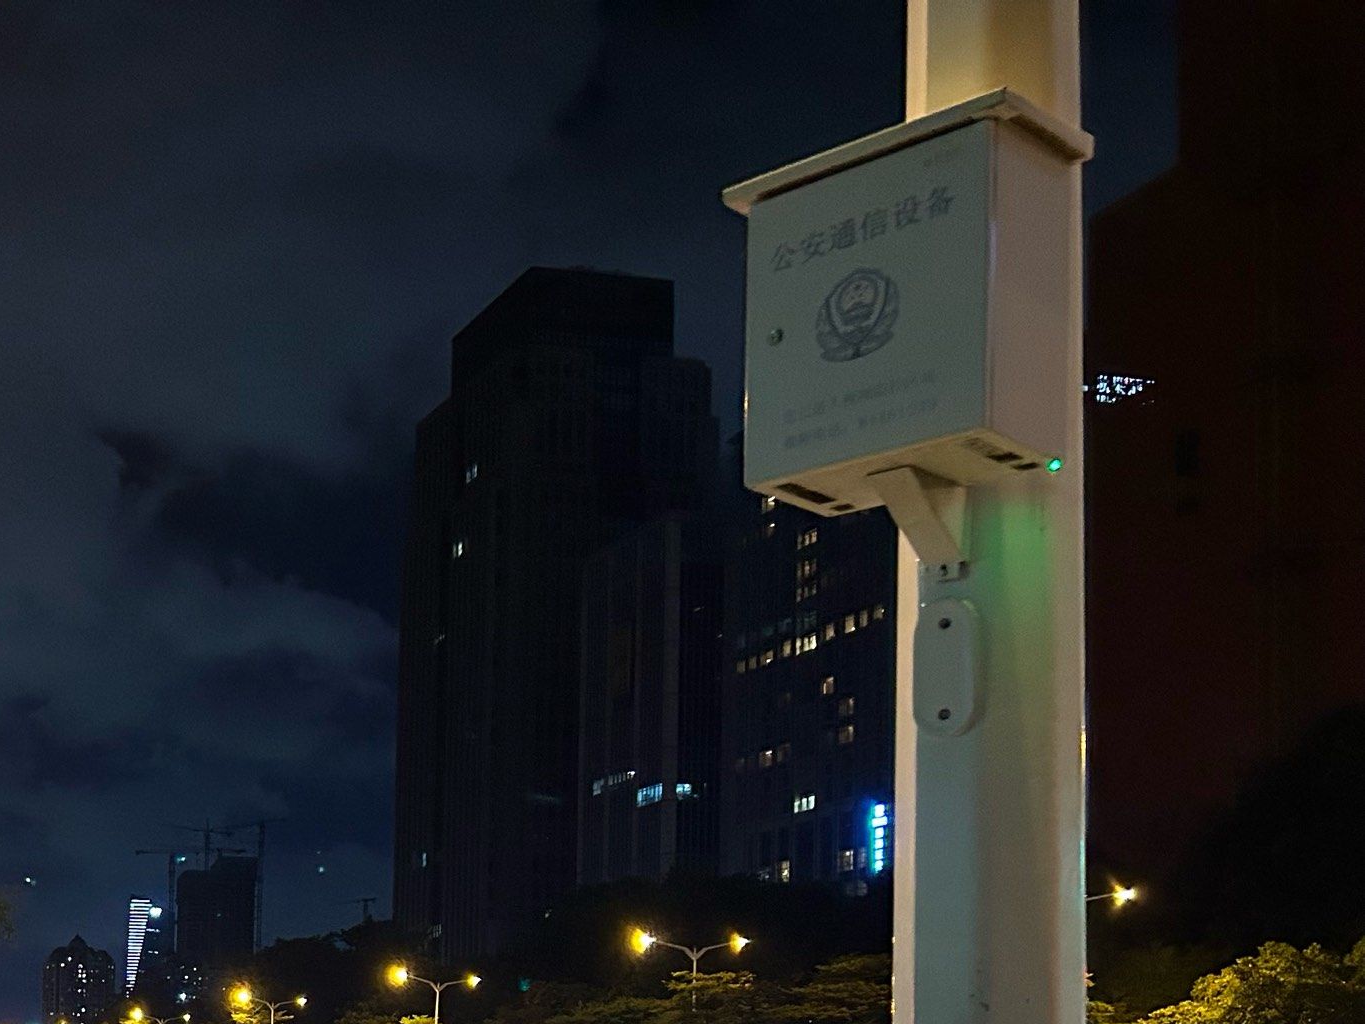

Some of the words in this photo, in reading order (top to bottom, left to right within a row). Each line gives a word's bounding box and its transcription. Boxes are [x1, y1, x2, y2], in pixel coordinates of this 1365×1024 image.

[770, 186, 955, 273] 公安通信设备
